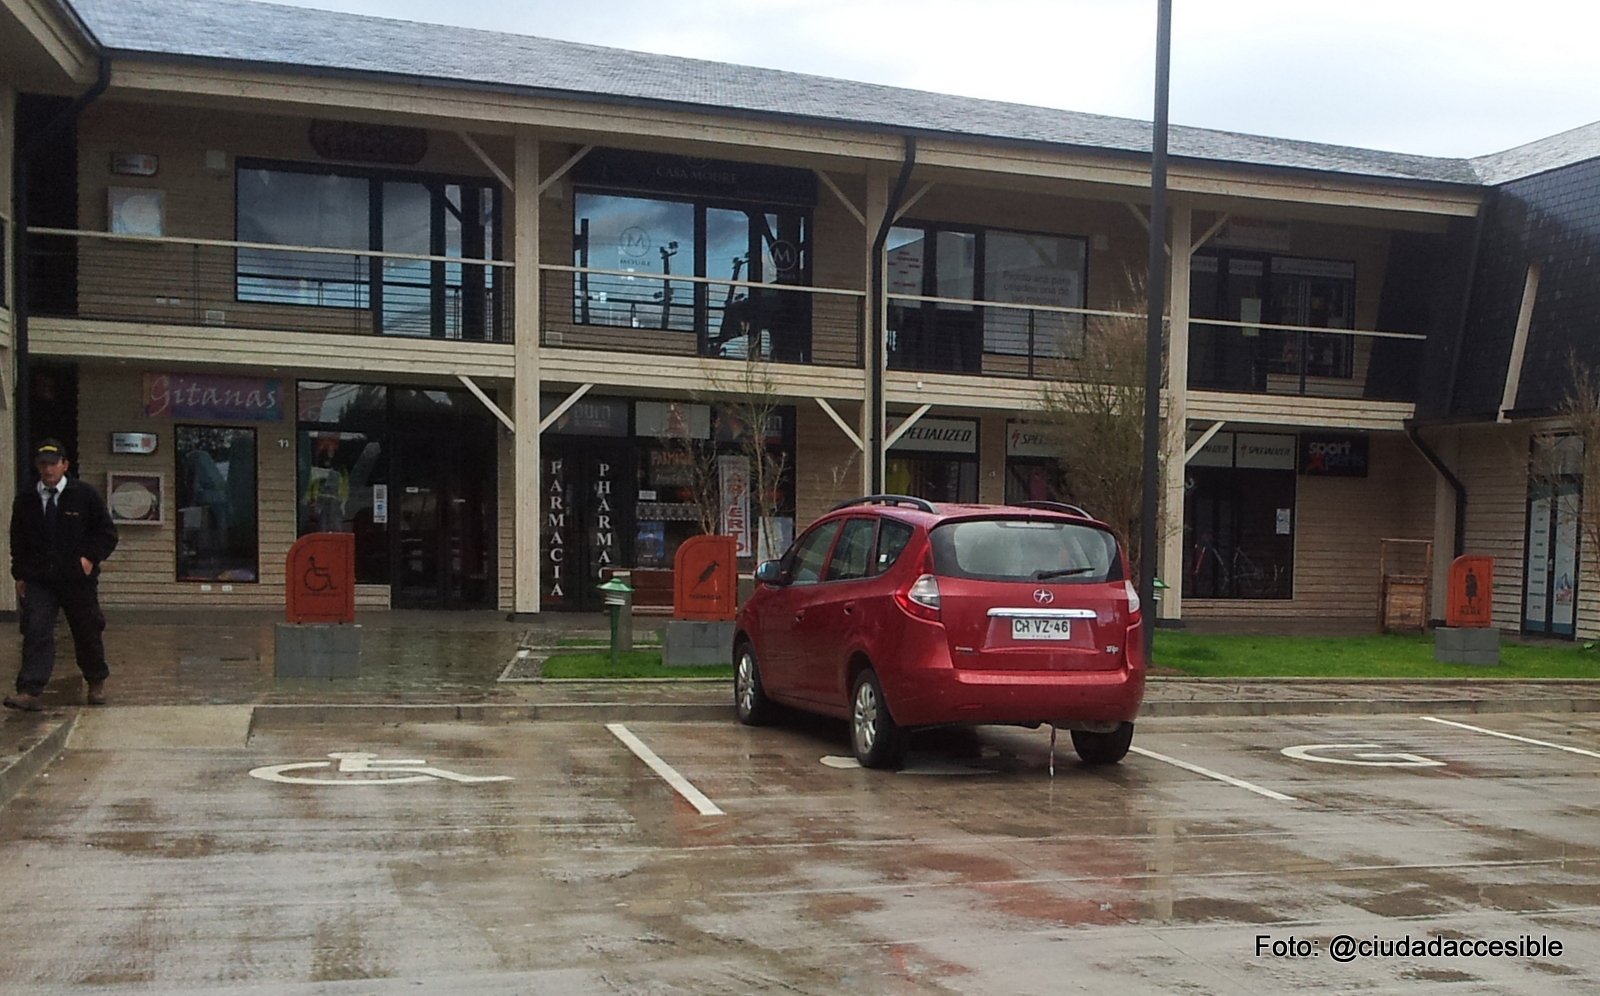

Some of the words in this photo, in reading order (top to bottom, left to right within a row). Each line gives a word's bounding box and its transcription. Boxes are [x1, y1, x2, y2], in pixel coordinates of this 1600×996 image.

[150, 375, 276, 416] Gitanas
[901, 427, 972, 442] PECIALIZED
[1308, 440, 1351, 457] sport
[548, 460, 565, 596] FARMACIA
